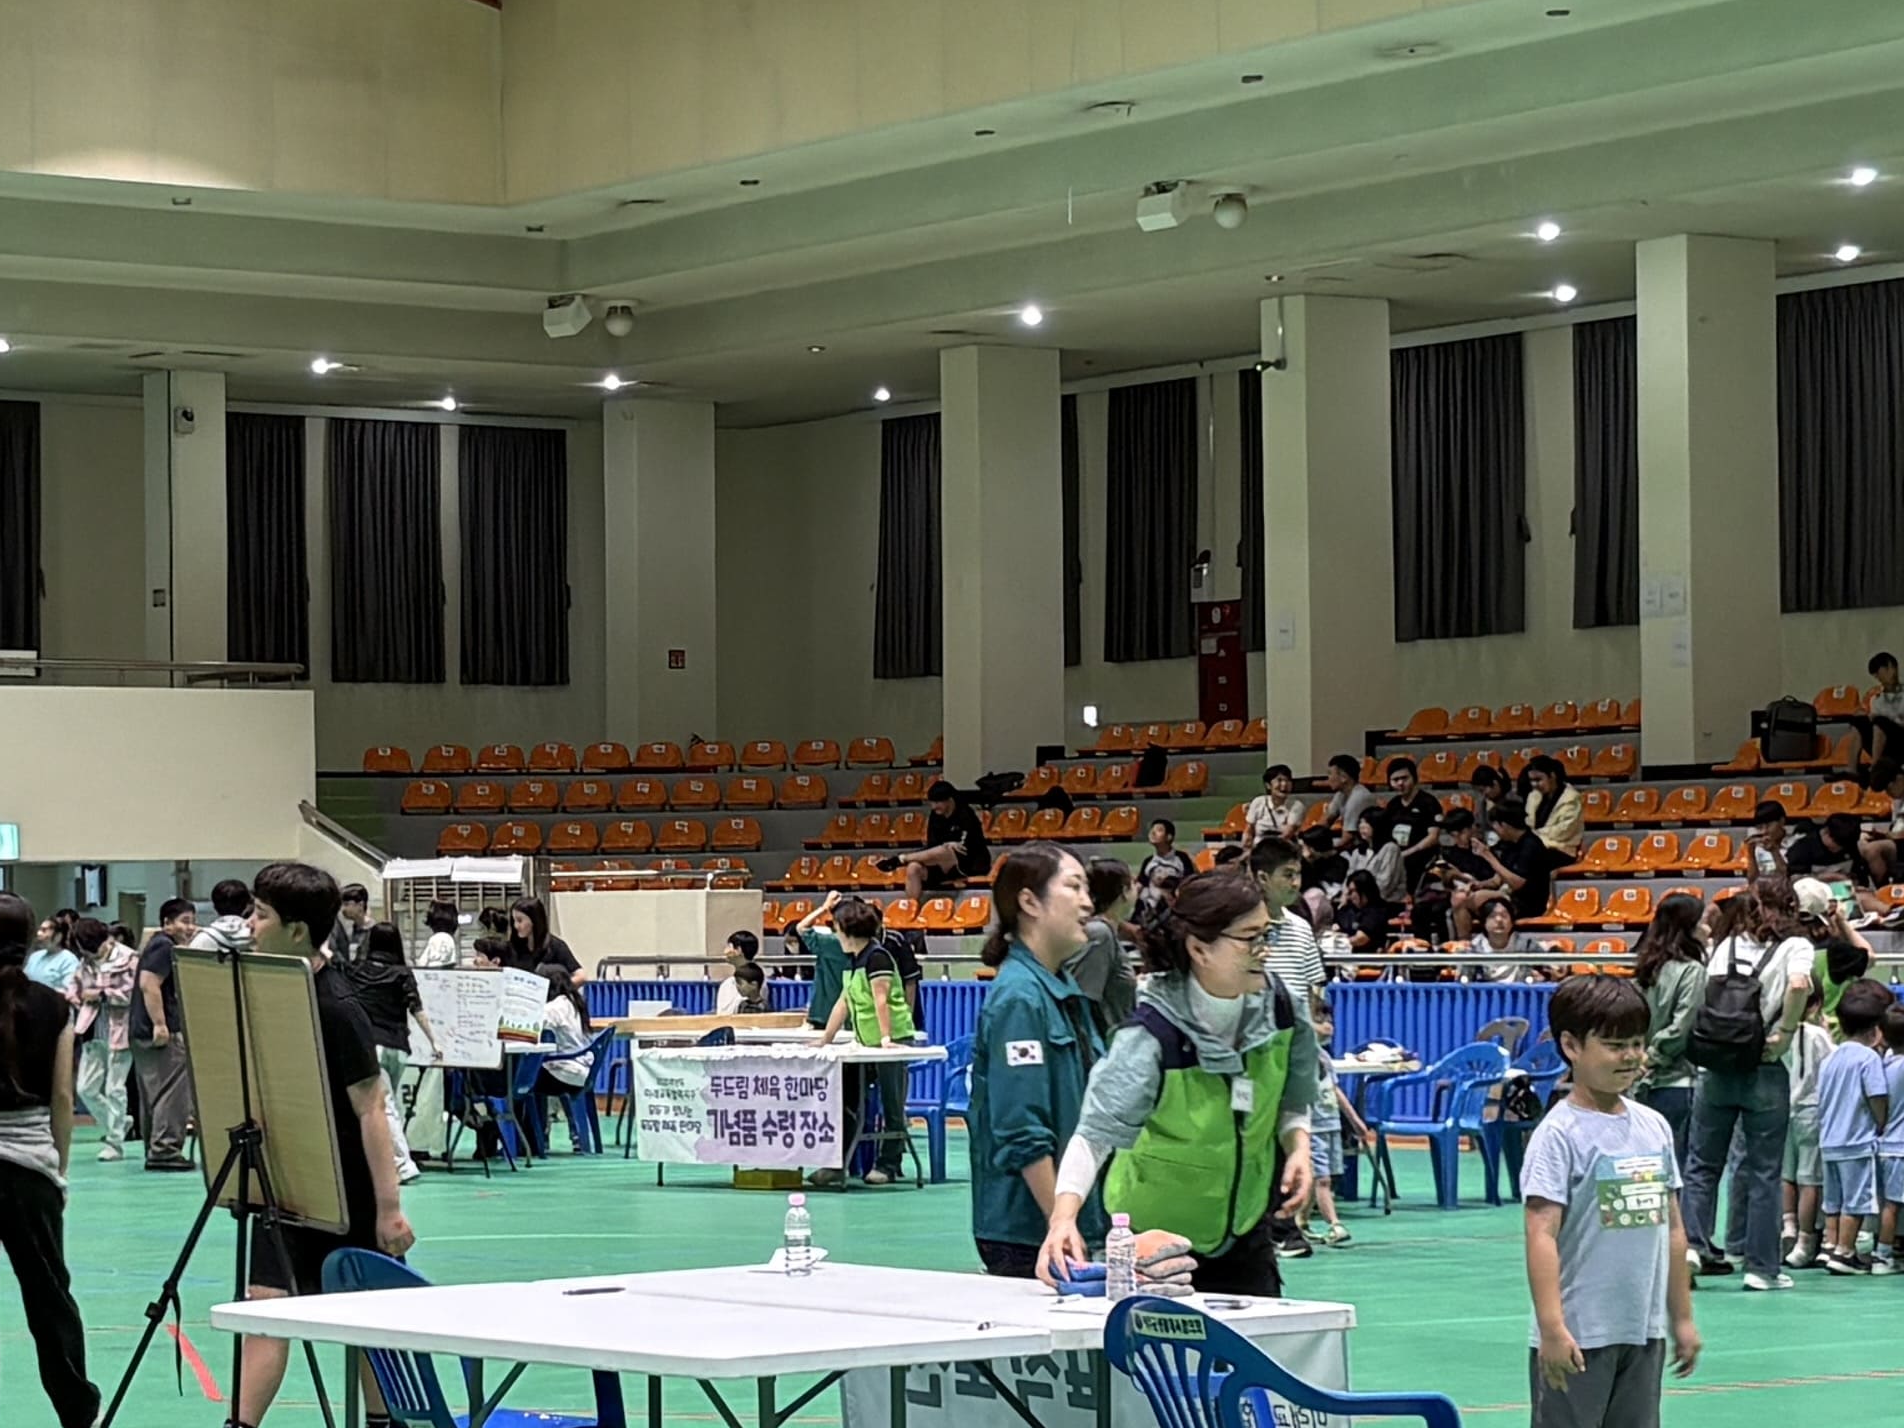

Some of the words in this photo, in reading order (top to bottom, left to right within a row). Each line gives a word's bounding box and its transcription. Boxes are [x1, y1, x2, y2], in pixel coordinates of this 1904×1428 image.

[710, 1076, 750, 1100] 두드림
[753, 1075, 780, 1101] 체육
[784, 1076, 829, 1102] 한마당
[706, 1109, 757, 1147] 기념품
[761, 1110, 796, 1149] 수령
[800, 1110, 835, 1150] 장소
